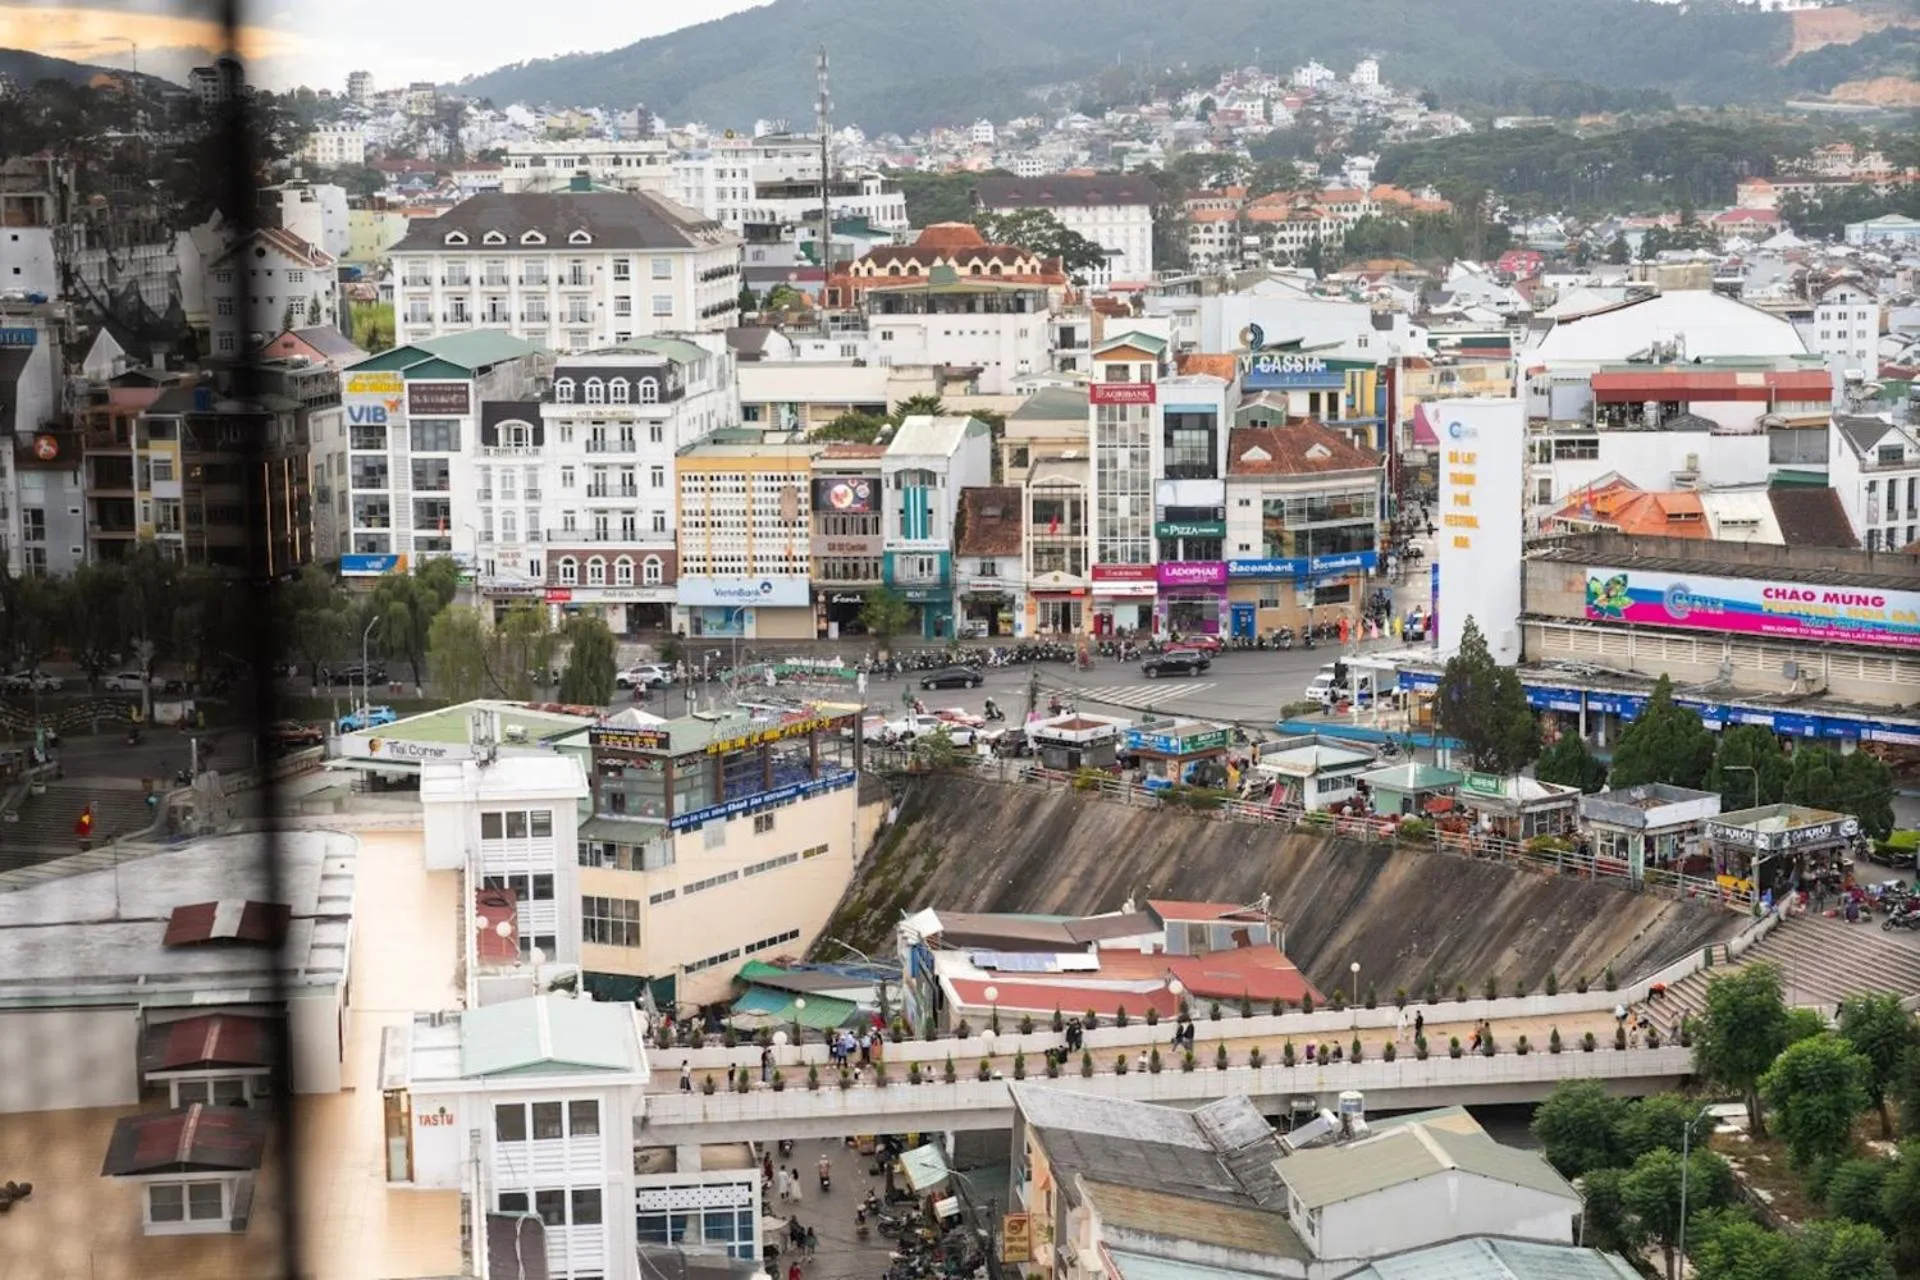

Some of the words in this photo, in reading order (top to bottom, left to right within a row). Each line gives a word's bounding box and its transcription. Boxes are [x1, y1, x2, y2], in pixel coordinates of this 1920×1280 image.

[1260, 356, 1322, 373] CASSIA
[348, 405, 387, 423] VIB
[1170, 525, 1199, 536] PIZZA
[366, 557, 383, 569] VIB
[1228, 561, 1295, 573] Sacombank
[1313, 555, 1363, 571] Sacombank
[1165, 567, 1218, 577] LADOPHAR
[1761, 624, 1798, 634] WELCOME
[1799, 627, 1809, 635] TO
[1810, 628, 1825, 636] THE
[1852, 632, 1867, 640] LAT
[1868, 633, 1898, 643] FLOWER
[408, 744, 447, 757] Corner
